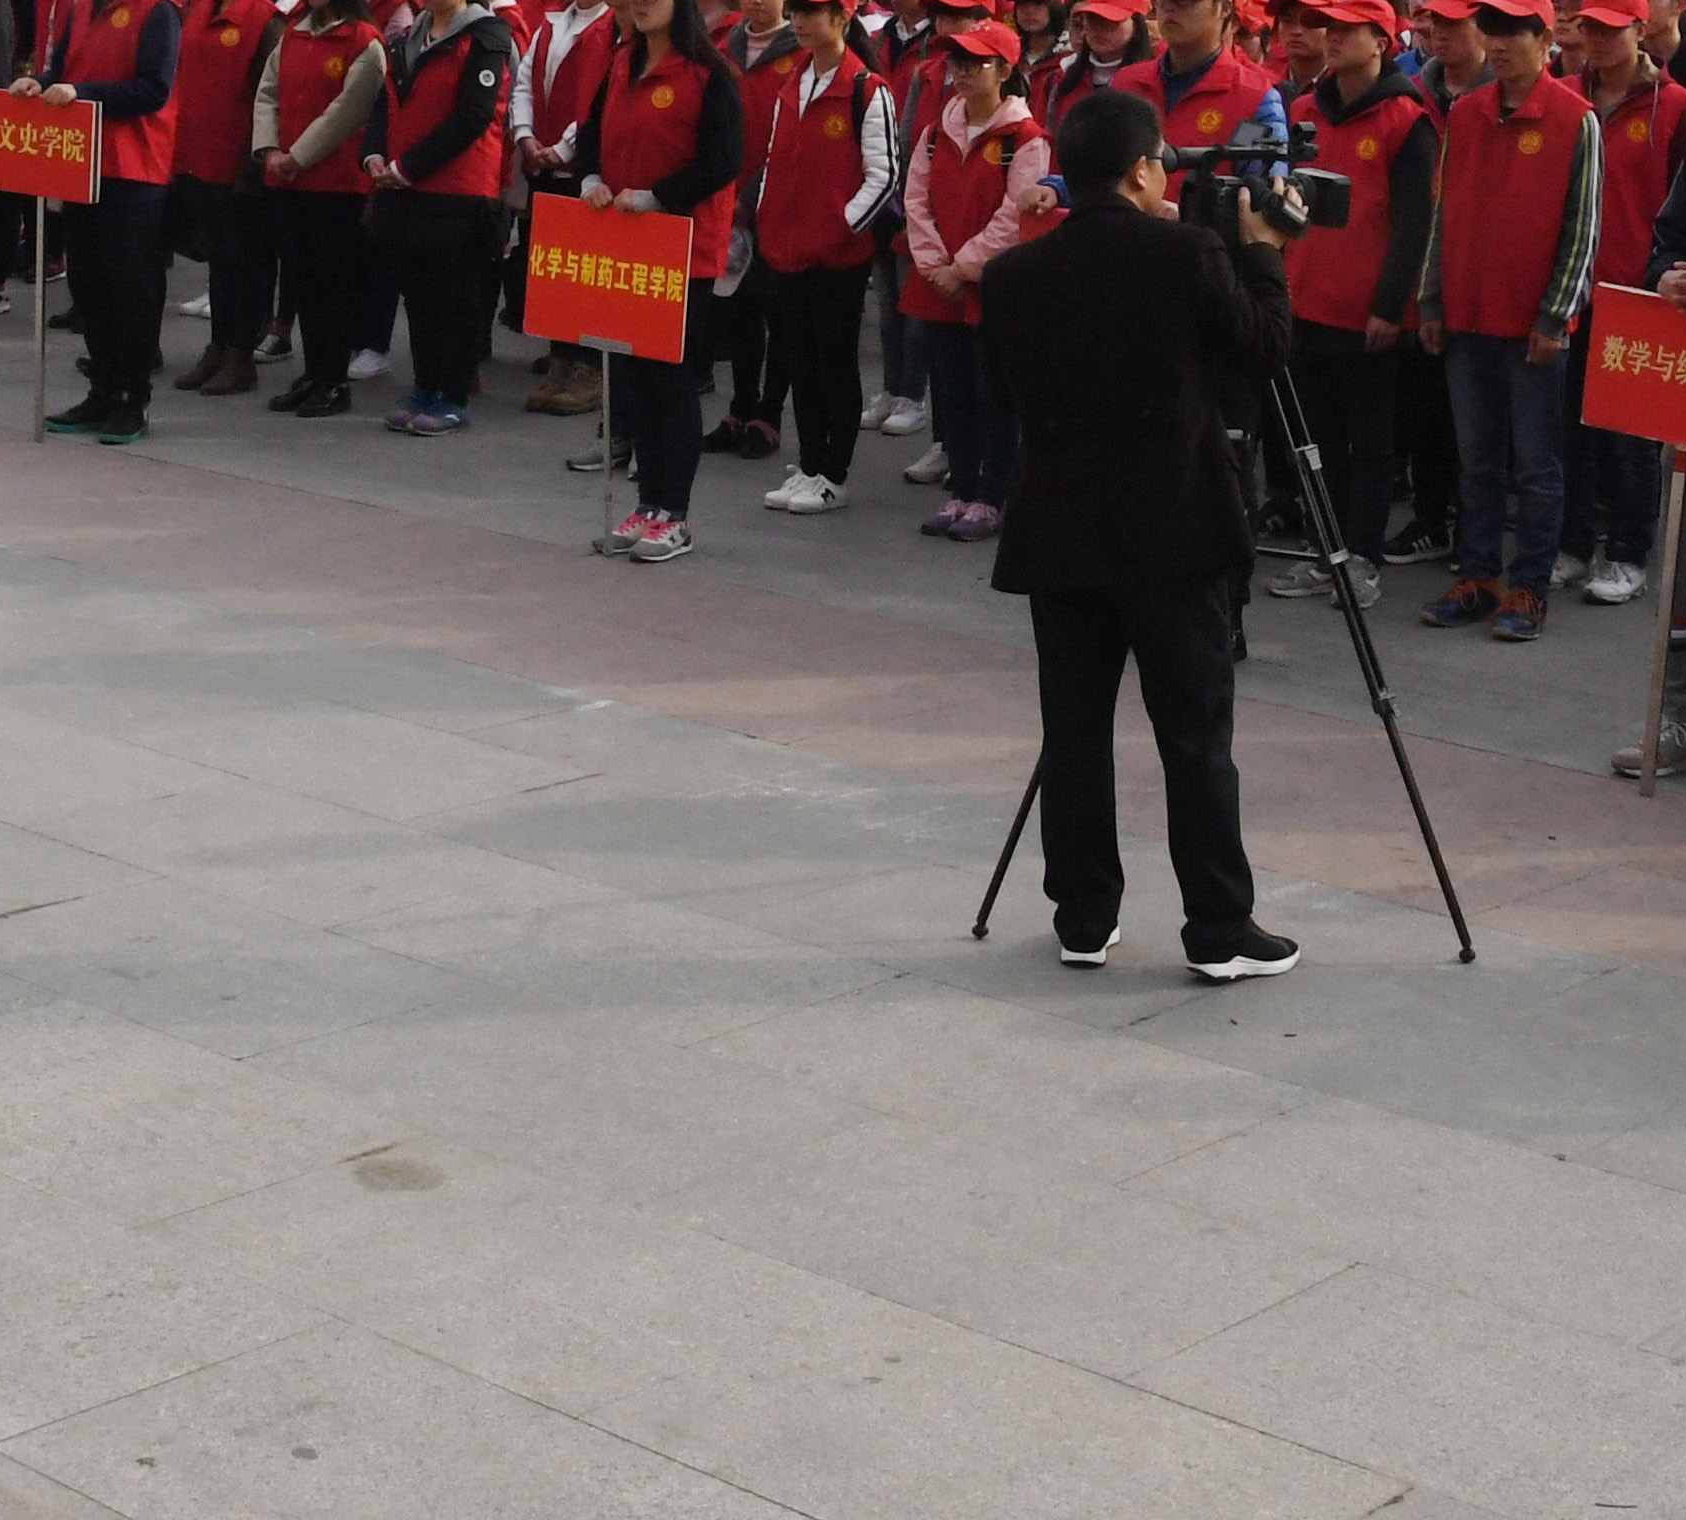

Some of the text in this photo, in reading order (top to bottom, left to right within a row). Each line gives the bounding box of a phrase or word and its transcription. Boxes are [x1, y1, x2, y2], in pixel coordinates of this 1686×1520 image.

[530, 244, 684, 303] 化学与制药工程学院
